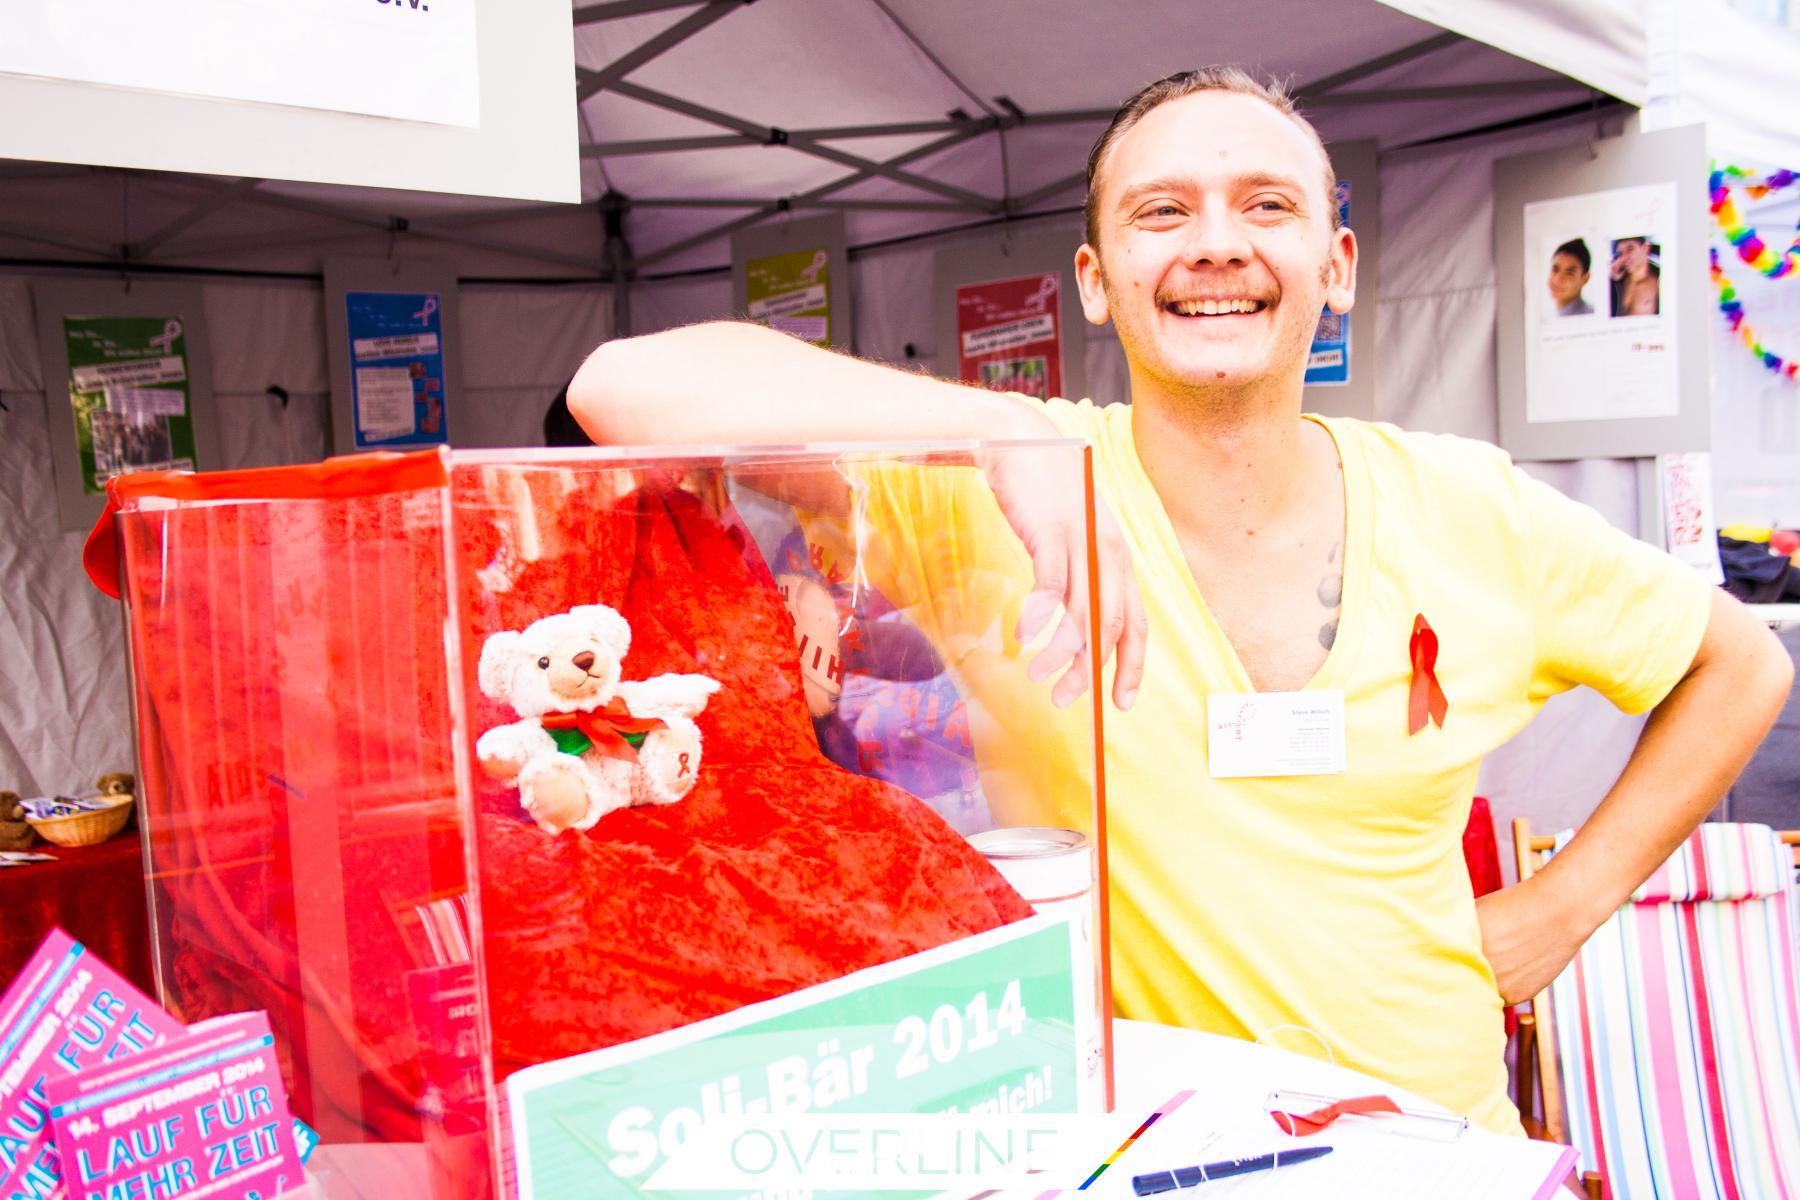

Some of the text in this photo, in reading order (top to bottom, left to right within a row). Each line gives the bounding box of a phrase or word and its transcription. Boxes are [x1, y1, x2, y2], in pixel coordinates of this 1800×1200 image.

[0, 1012, 61, 1097] TEMBER
[54, 968, 94, 1018] 2014
[53, 990, 126, 1076] FÜR
[606, 1038, 875, 1178] Soli-Bär
[893, 979, 1027, 1080] 2014
[68, 1117, 100, 1140] 14.
[102, 1072, 221, 1128] SEPTEMBER
[222, 1056, 266, 1085] 2014
[76, 1115, 183, 1186] LAUF
[194, 1085, 272, 1140] FÜR
[203, 1121, 280, 1181] ZEIT
